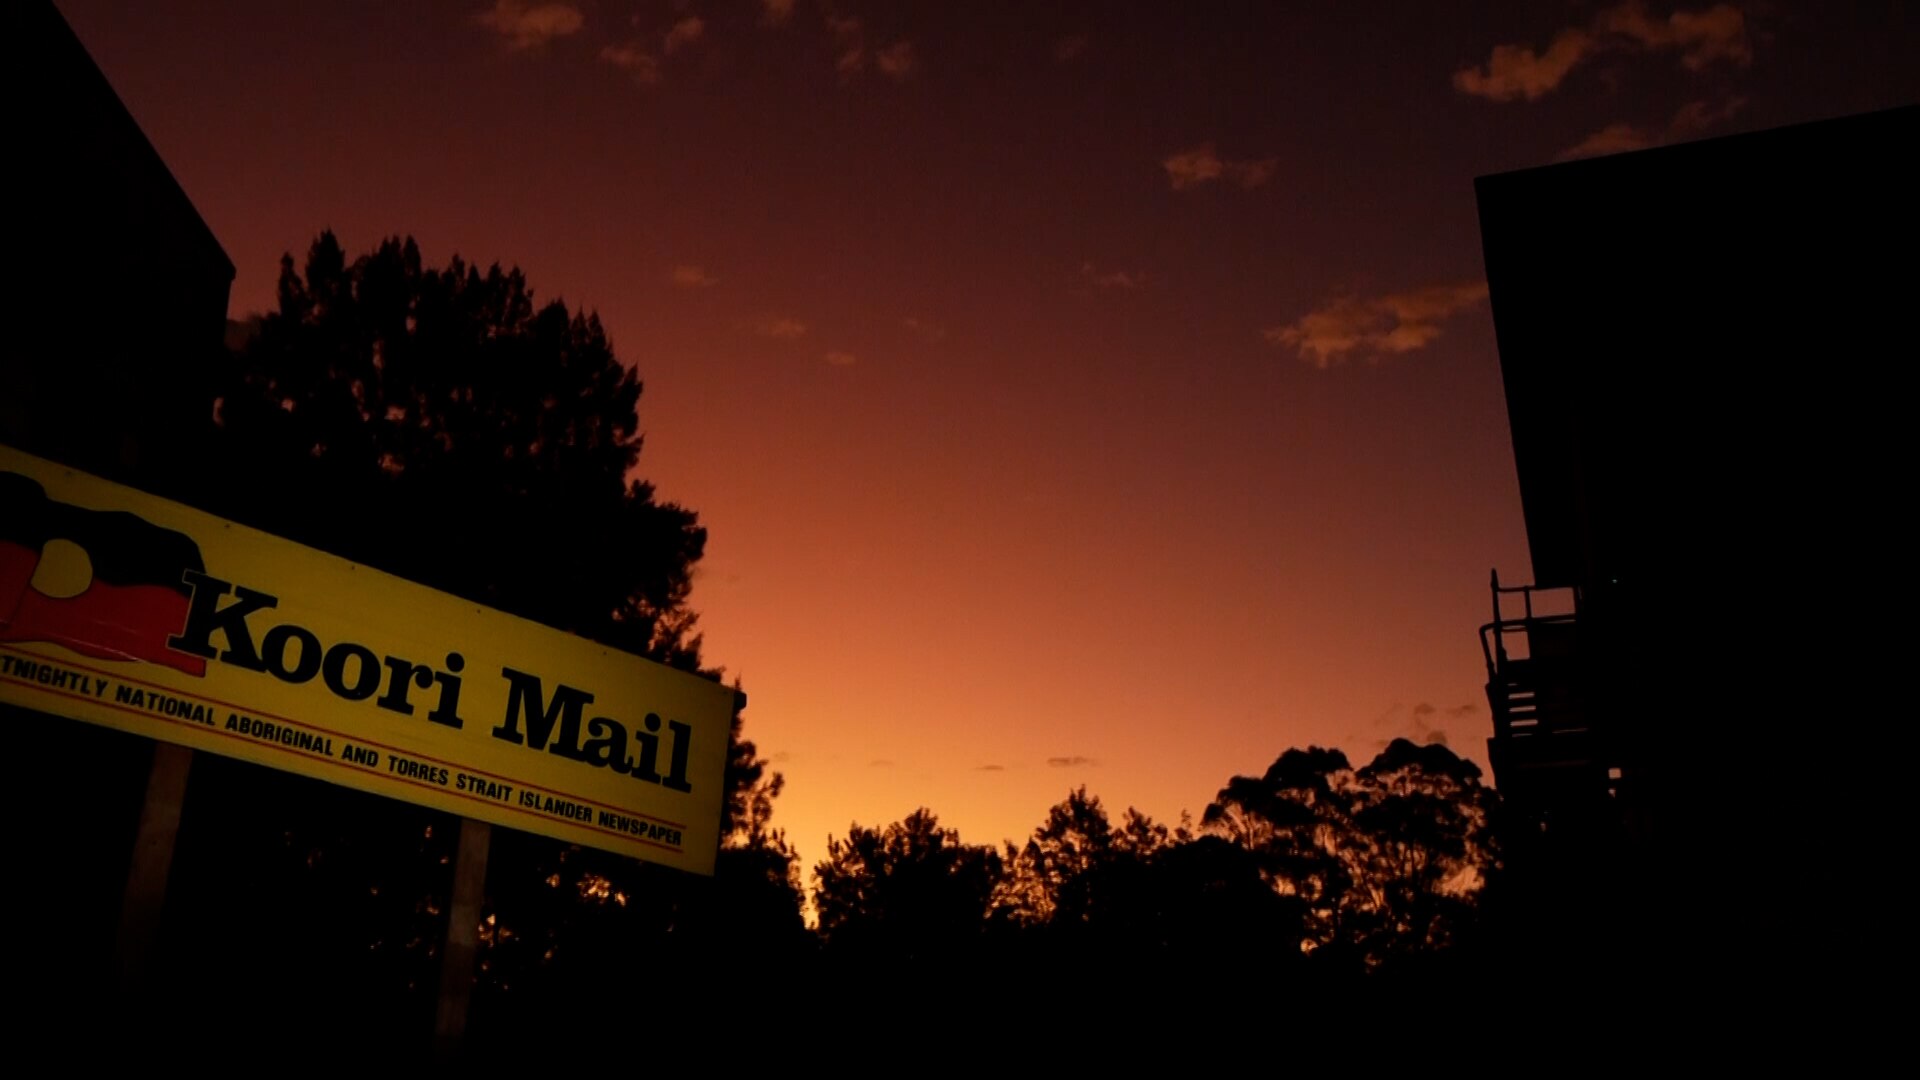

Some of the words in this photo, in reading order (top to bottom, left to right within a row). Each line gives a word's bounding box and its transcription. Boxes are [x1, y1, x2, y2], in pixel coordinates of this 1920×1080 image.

[116, 685, 215, 726] NATIONAL
[226, 714, 333, 756] ABORIGINAL
[342, 745, 378, 767] AND
[388, 755, 449, 785] TORRES
[456, 773, 513, 802] STRAIT
[519, 791, 593, 822] ISLANDER
[599, 811, 682, 846] NEWSPAPER
[168, 570, 465, 728] Koori
[493, 667, 692, 793] Mail
